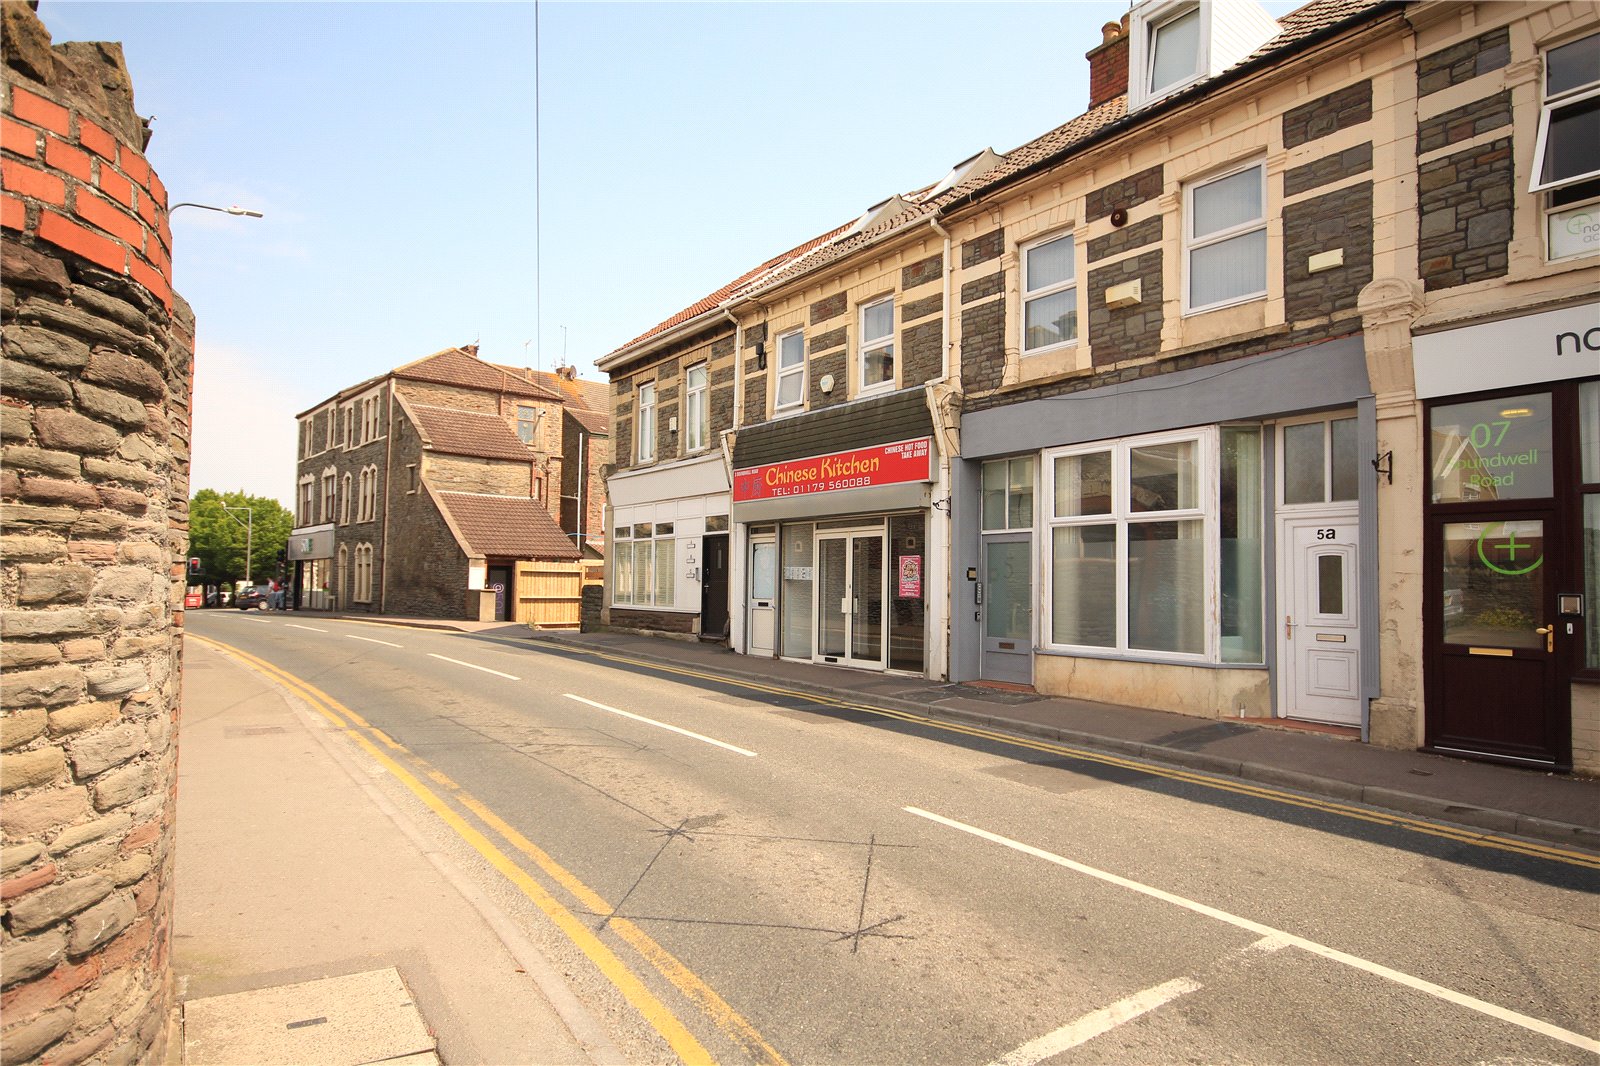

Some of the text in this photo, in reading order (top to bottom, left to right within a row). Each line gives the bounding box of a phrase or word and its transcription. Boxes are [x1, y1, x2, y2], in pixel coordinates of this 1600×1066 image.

[1471, 421, 1511, 448] 07
[884, 440, 928, 455] CHINESE HOT FOOD
[901, 448, 928, 459] TAKE AWAY
[765, 454, 880, 486] Chinese Kitchen
[771, 476, 871, 497] TEL: 01179 560088
[1470, 471, 1514, 487] Road
[1316, 528, 1336, 540] 5a
